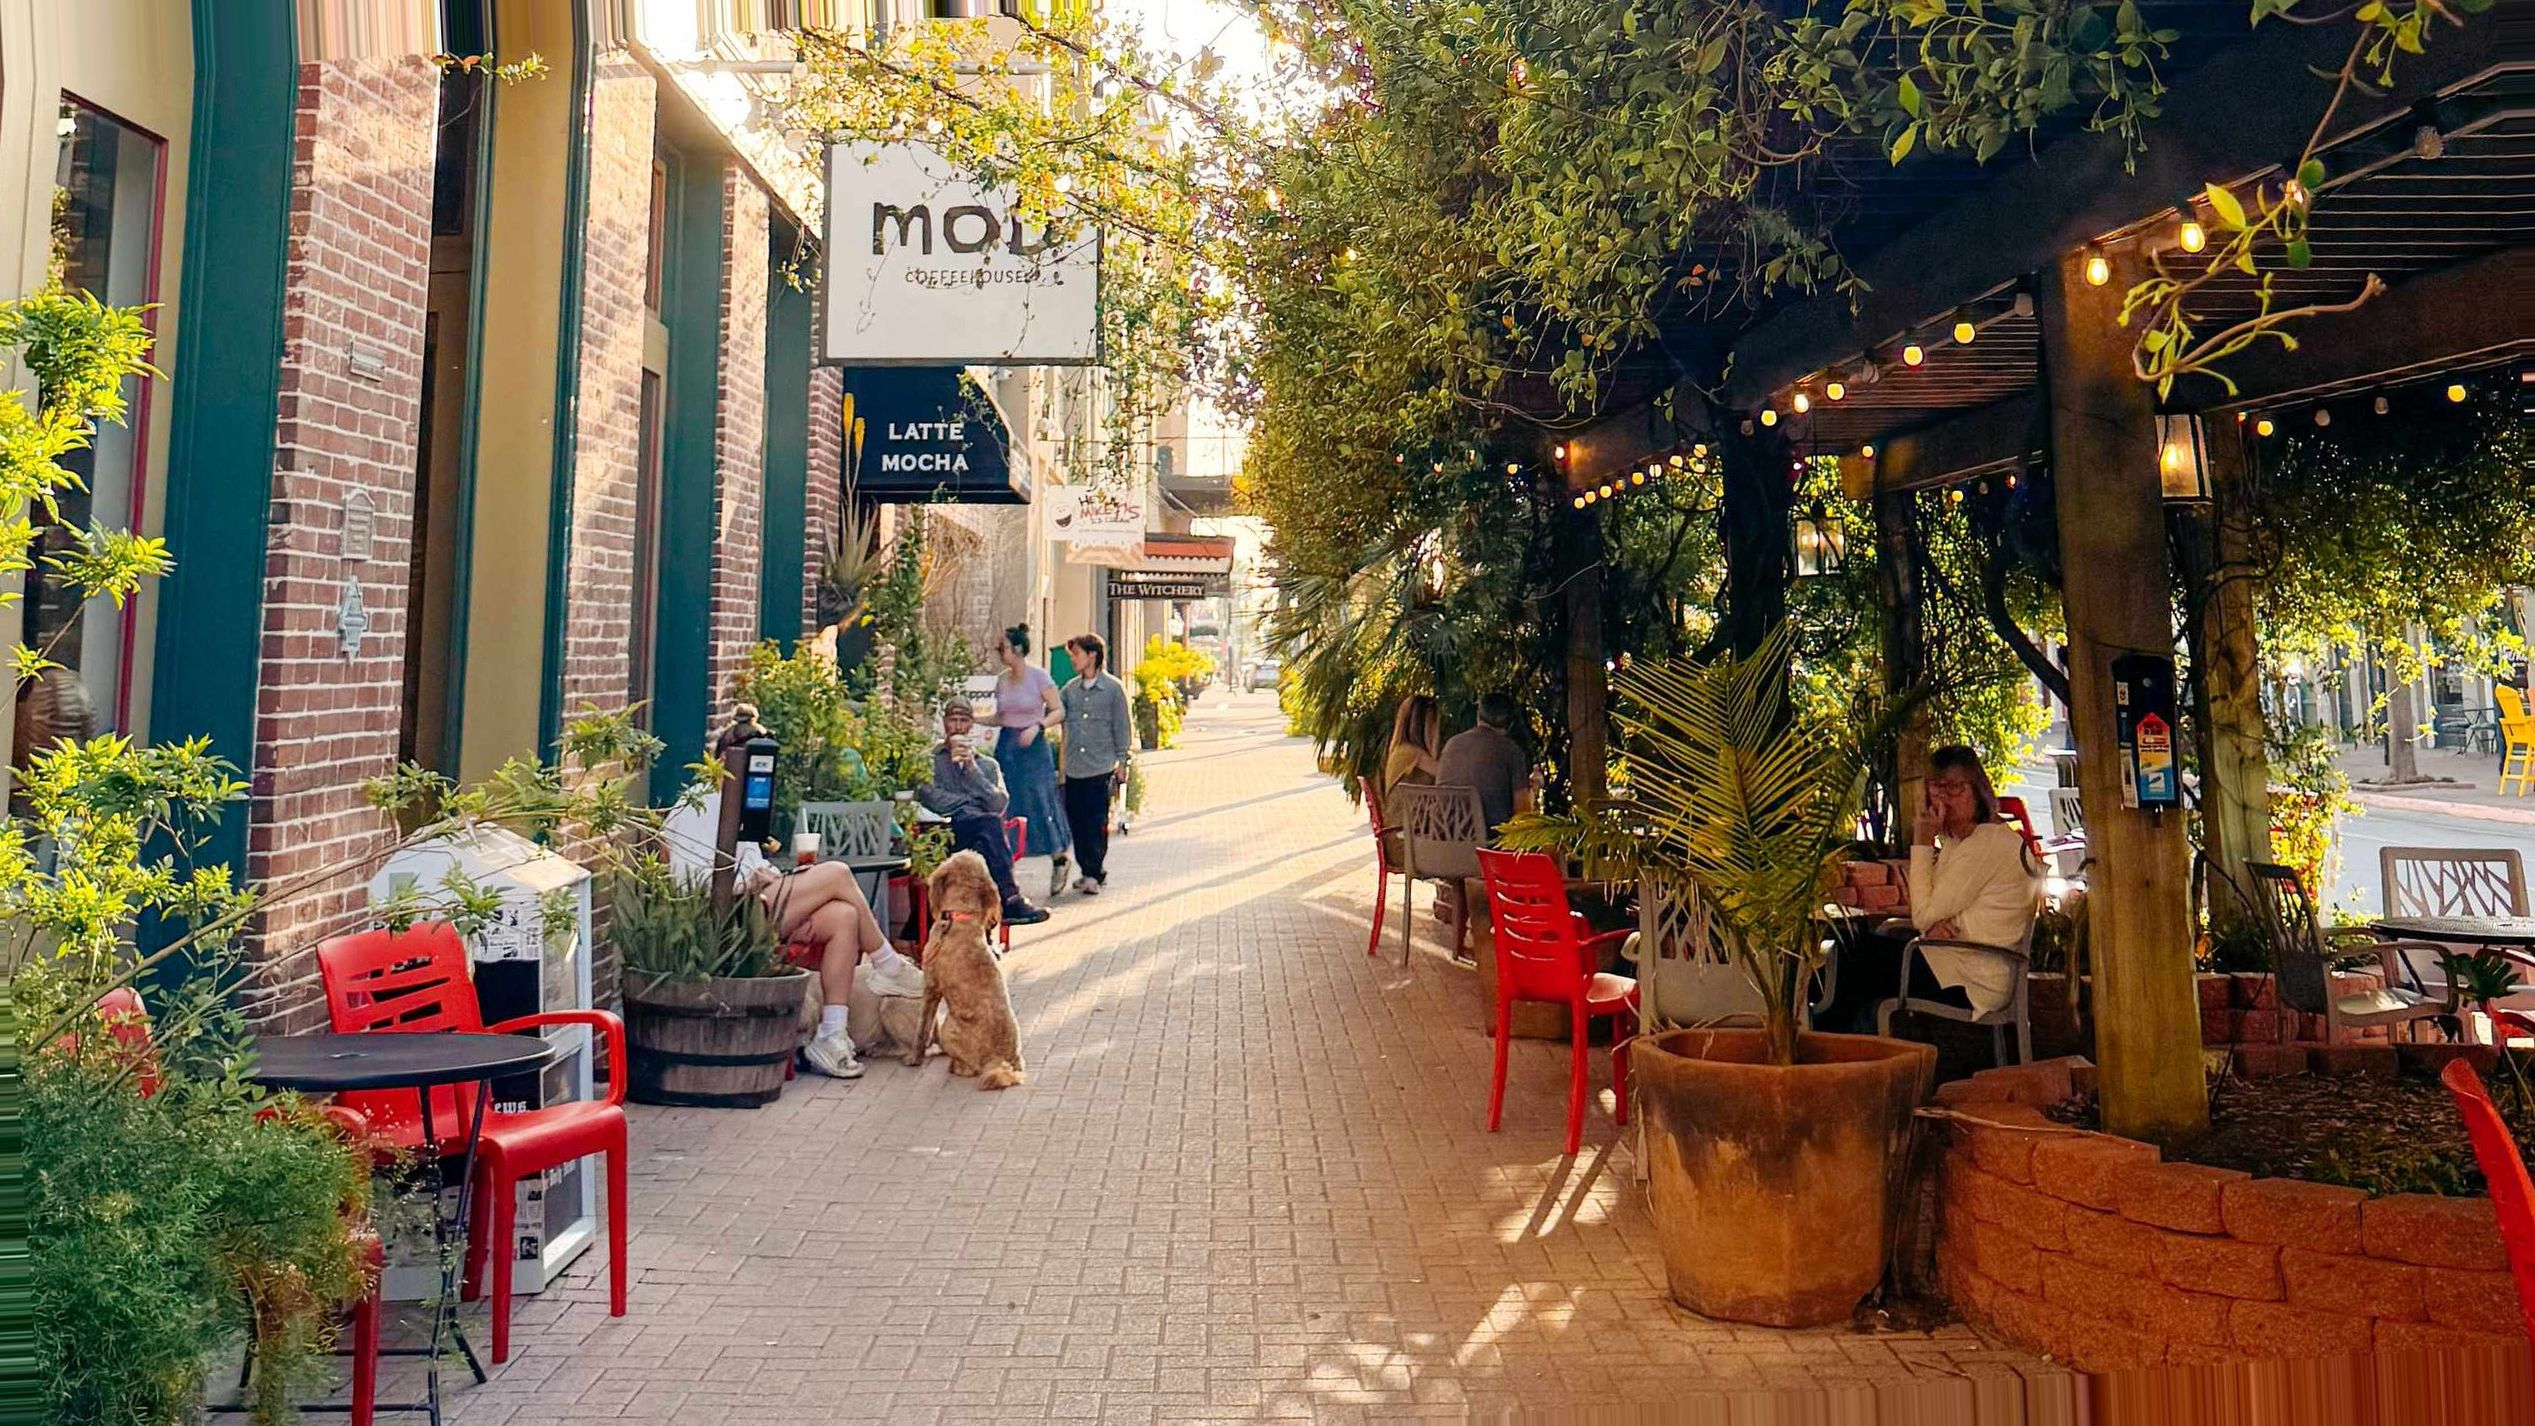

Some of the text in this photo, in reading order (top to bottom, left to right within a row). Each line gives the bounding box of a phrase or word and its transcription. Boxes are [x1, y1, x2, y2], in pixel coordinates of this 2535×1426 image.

[888, 422, 965, 440] LATTE
[881, 453, 970, 472] MOCHA
[1108, 582, 1205, 596] THE WITCHERY
[494, 1101, 531, 1114] ews.
